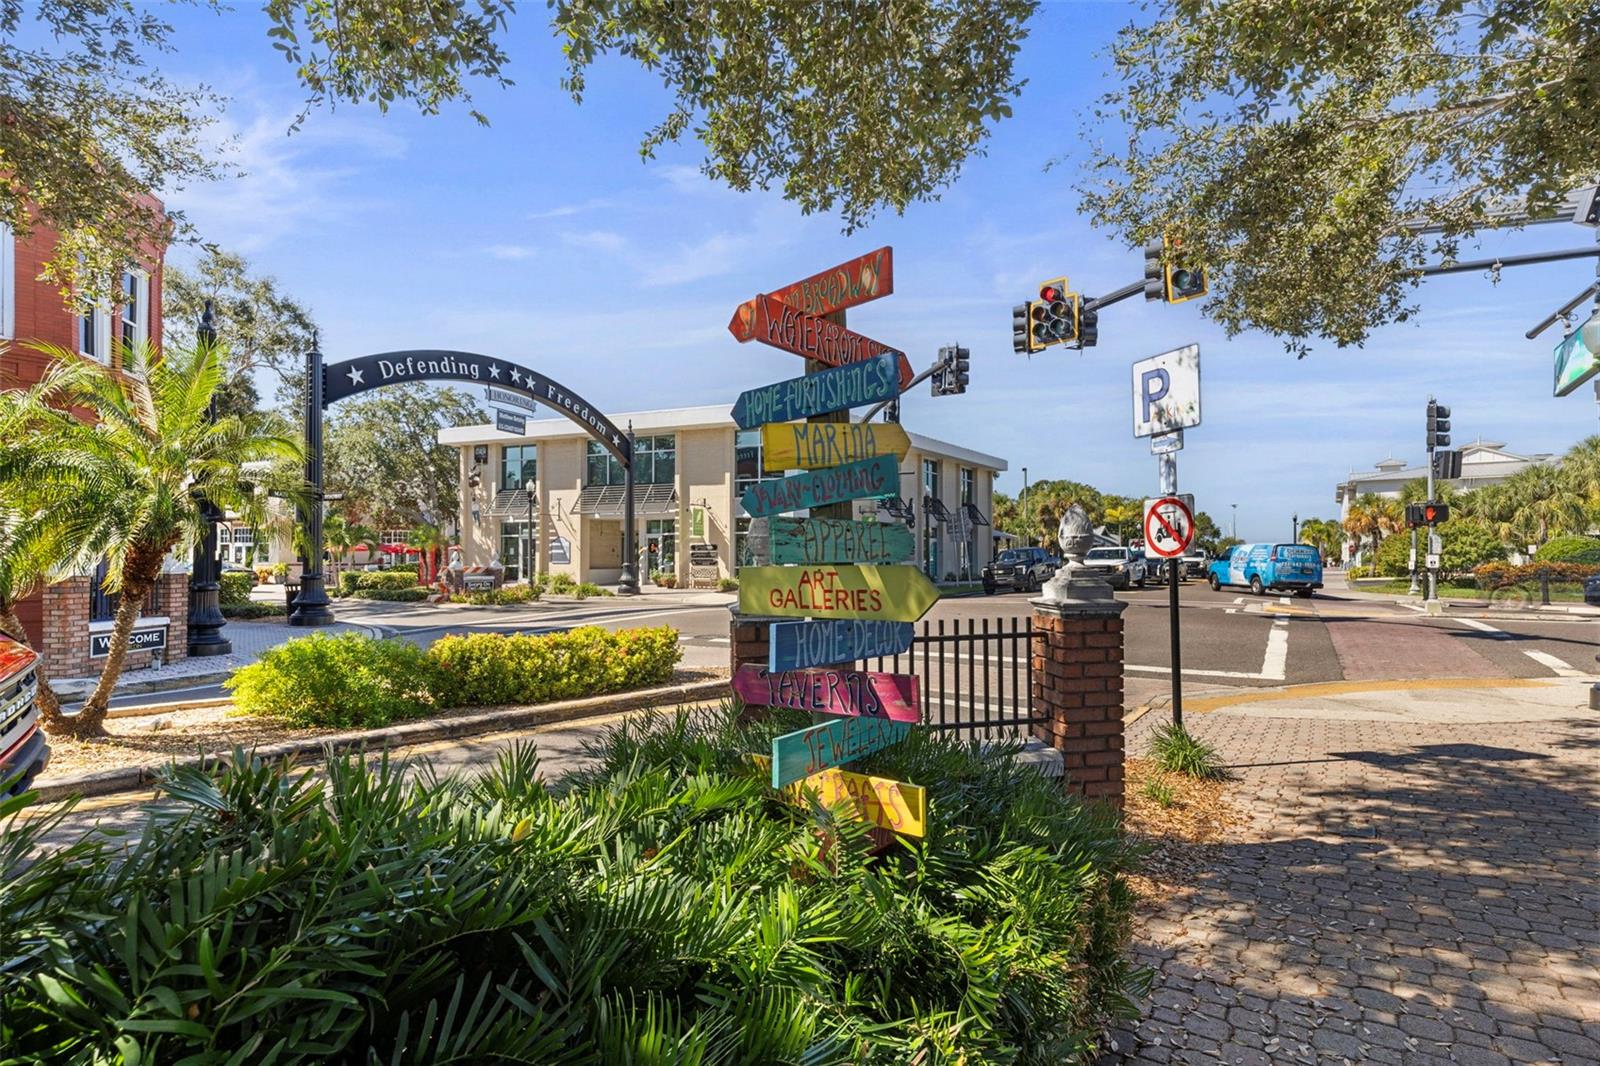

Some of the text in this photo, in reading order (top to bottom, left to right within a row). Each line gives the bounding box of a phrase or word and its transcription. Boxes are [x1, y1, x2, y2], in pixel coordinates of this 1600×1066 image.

[801, 252, 883, 315] BROADWAY
[761, 297, 863, 365] WATERFRONT
[378, 356, 607, 436] Defending Freedom
[745, 385, 783, 428] HOME
[783, 359, 889, 420] FURNISHINGS
[1142, 367, 1171, 424] P
[803, 519, 891, 562] APPAREL
[769, 588, 882, 612] GALLERIES
[800, 570, 839, 590] ART
[98, 632, 160, 649] WCOME
[795, 620, 906, 668] HOME DECOR
[758, 670, 880, 716] TAVERNS
